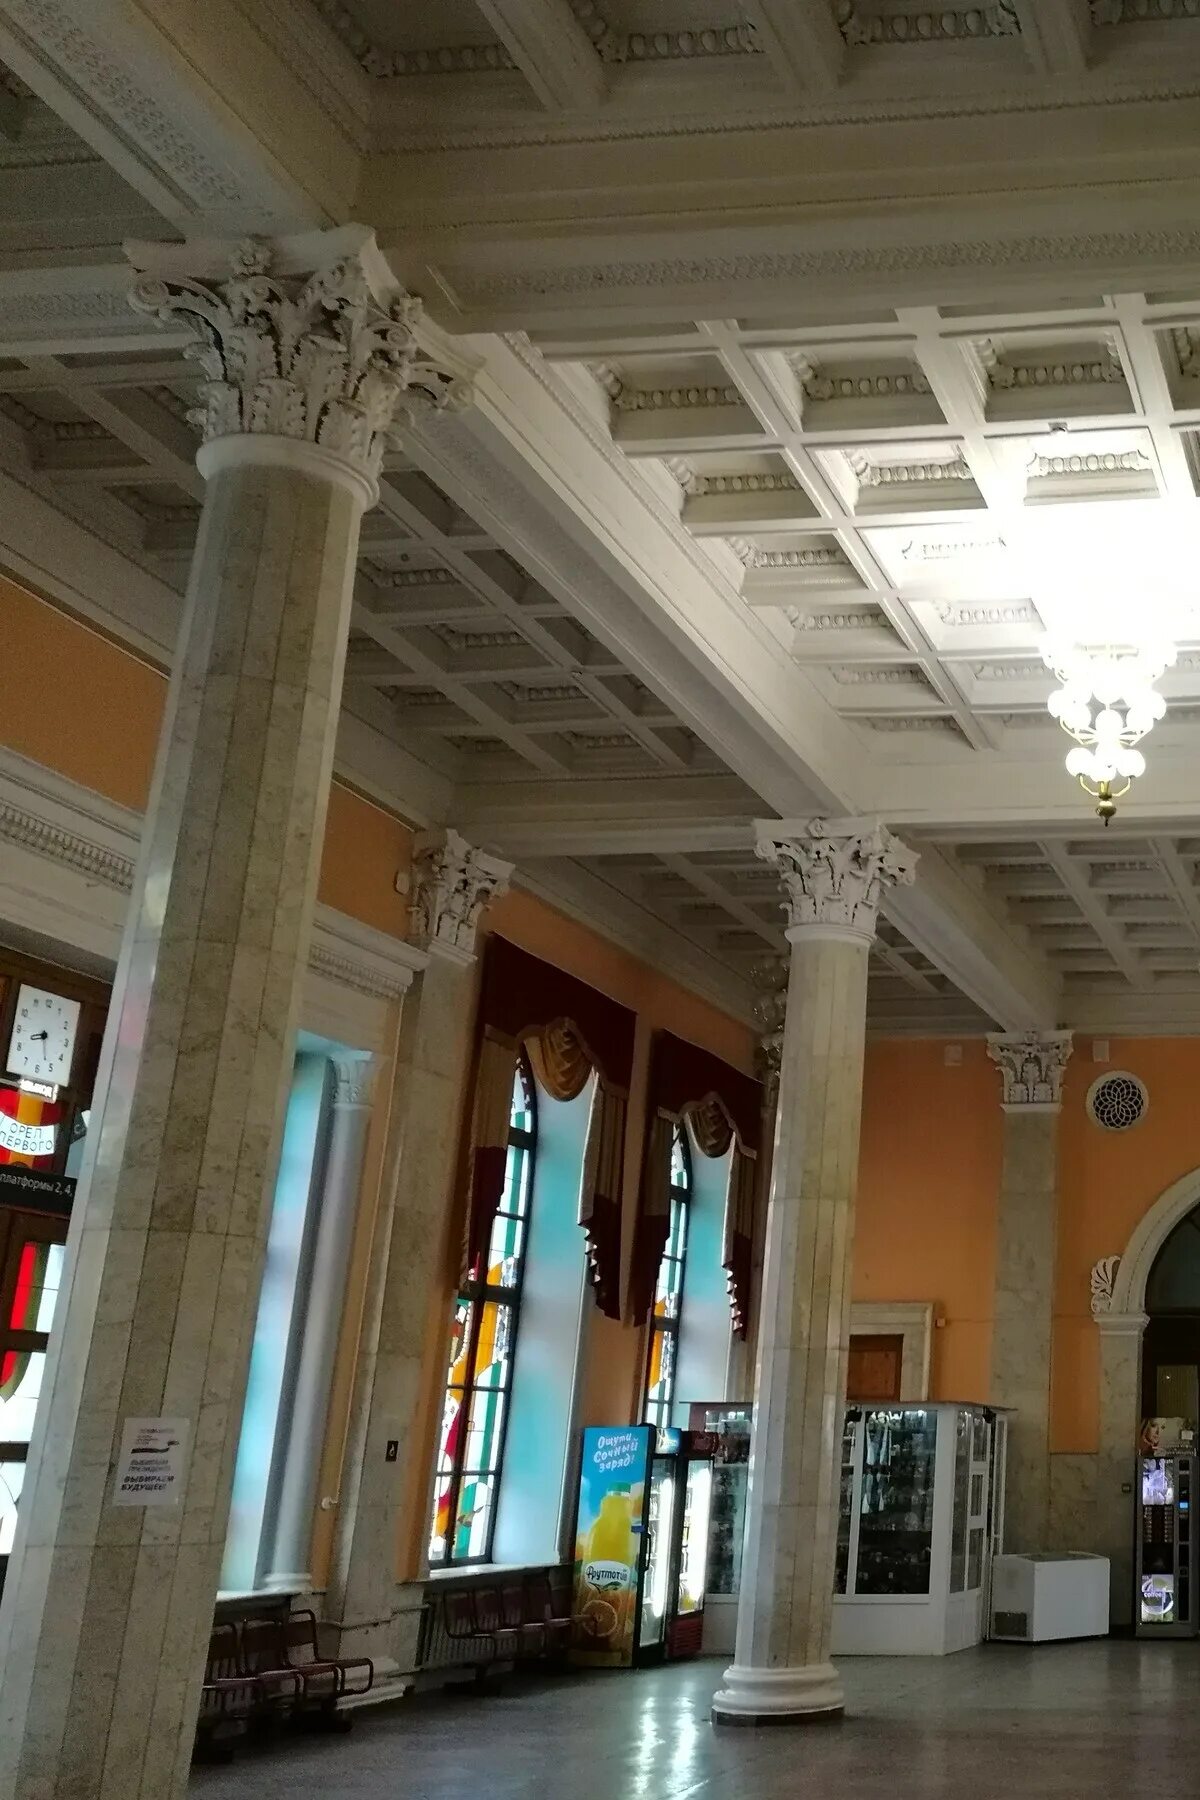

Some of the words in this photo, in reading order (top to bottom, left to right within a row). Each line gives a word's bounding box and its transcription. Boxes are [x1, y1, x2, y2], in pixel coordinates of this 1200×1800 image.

[46, 998, 53, 1009] 12
[21, 1007, 29, 1018] 10
[63, 1020, 68, 1031] 2
[64, 1038, 70, 1048] 3
[58, 1053, 64, 1062] 4
[34, 1064, 40, 1074] 6
[48, 1062, 54, 1073] 5
[0, 1173, 54, 1192] платформы
[597, 1432, 632, 1449] Ощути
[598, 1453, 635, 1473] заряд!
